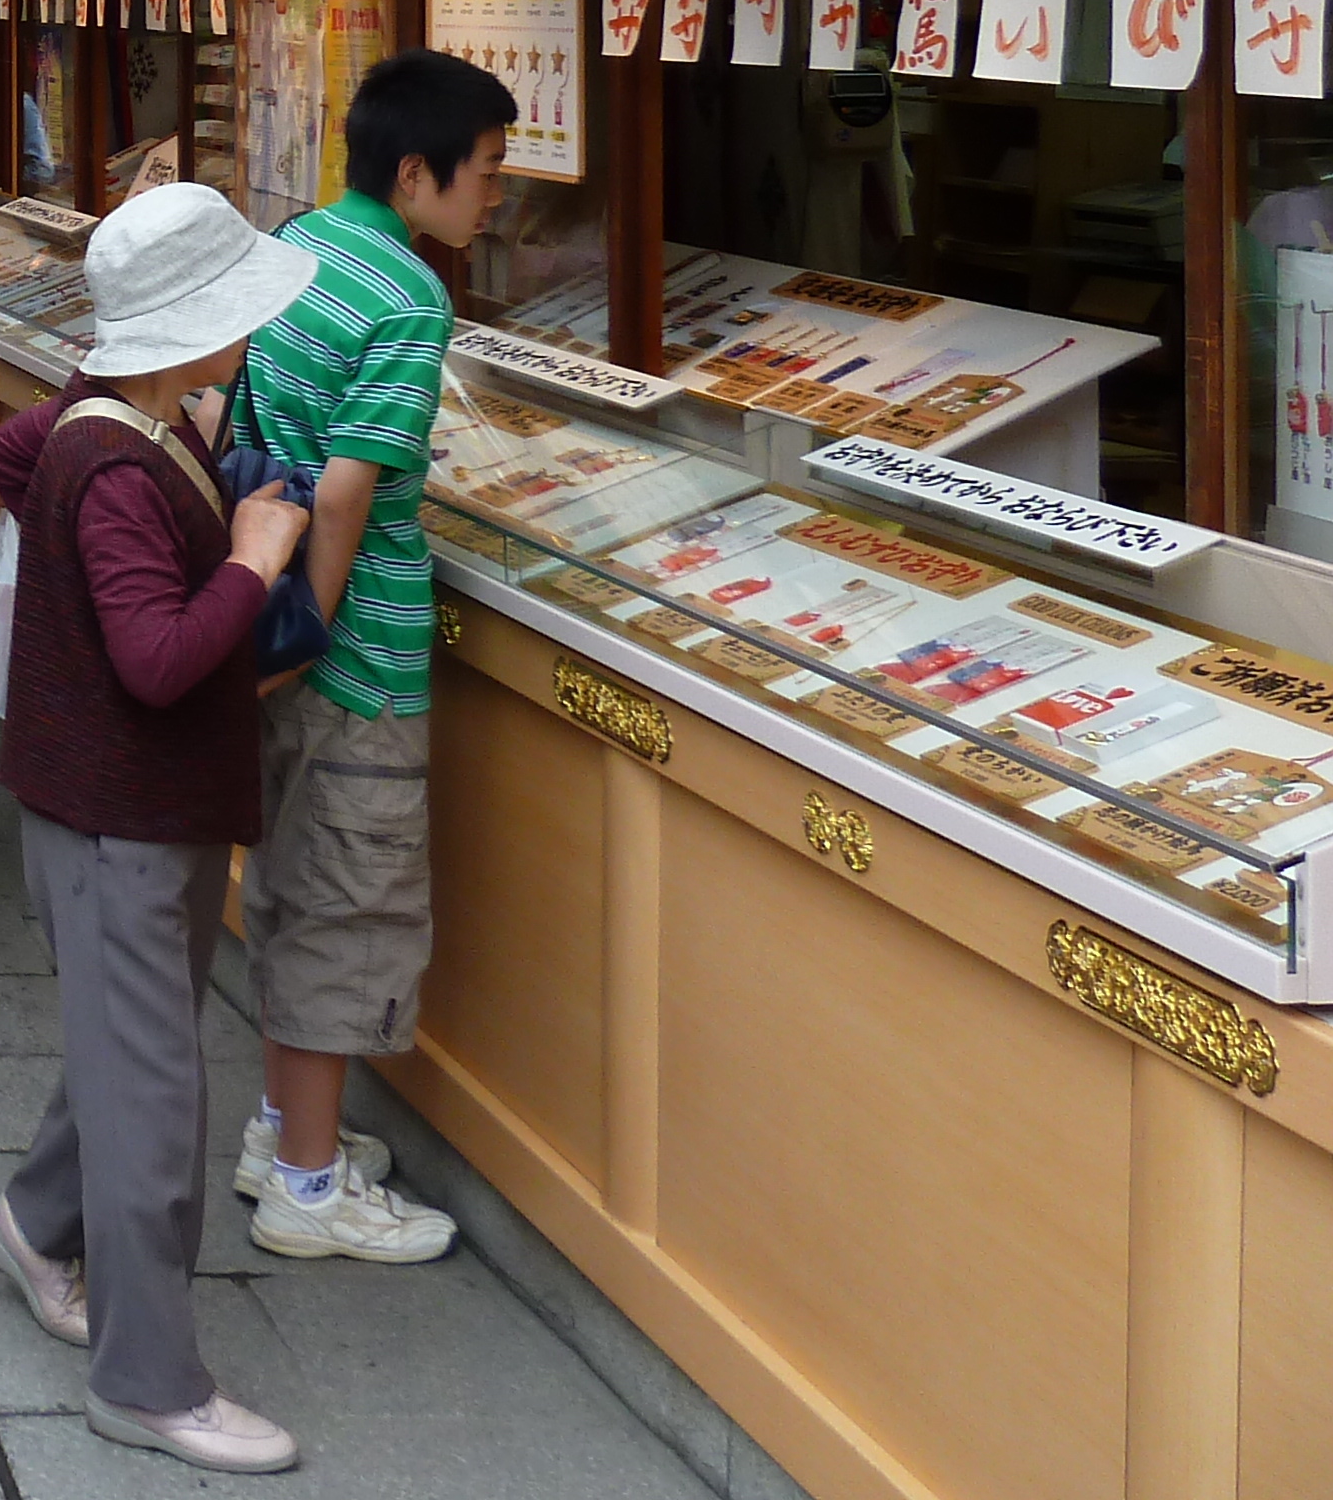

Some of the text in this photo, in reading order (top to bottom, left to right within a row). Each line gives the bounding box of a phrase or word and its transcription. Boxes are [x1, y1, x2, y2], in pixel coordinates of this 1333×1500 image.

[795, 518, 984, 589] えんむすびお守り
